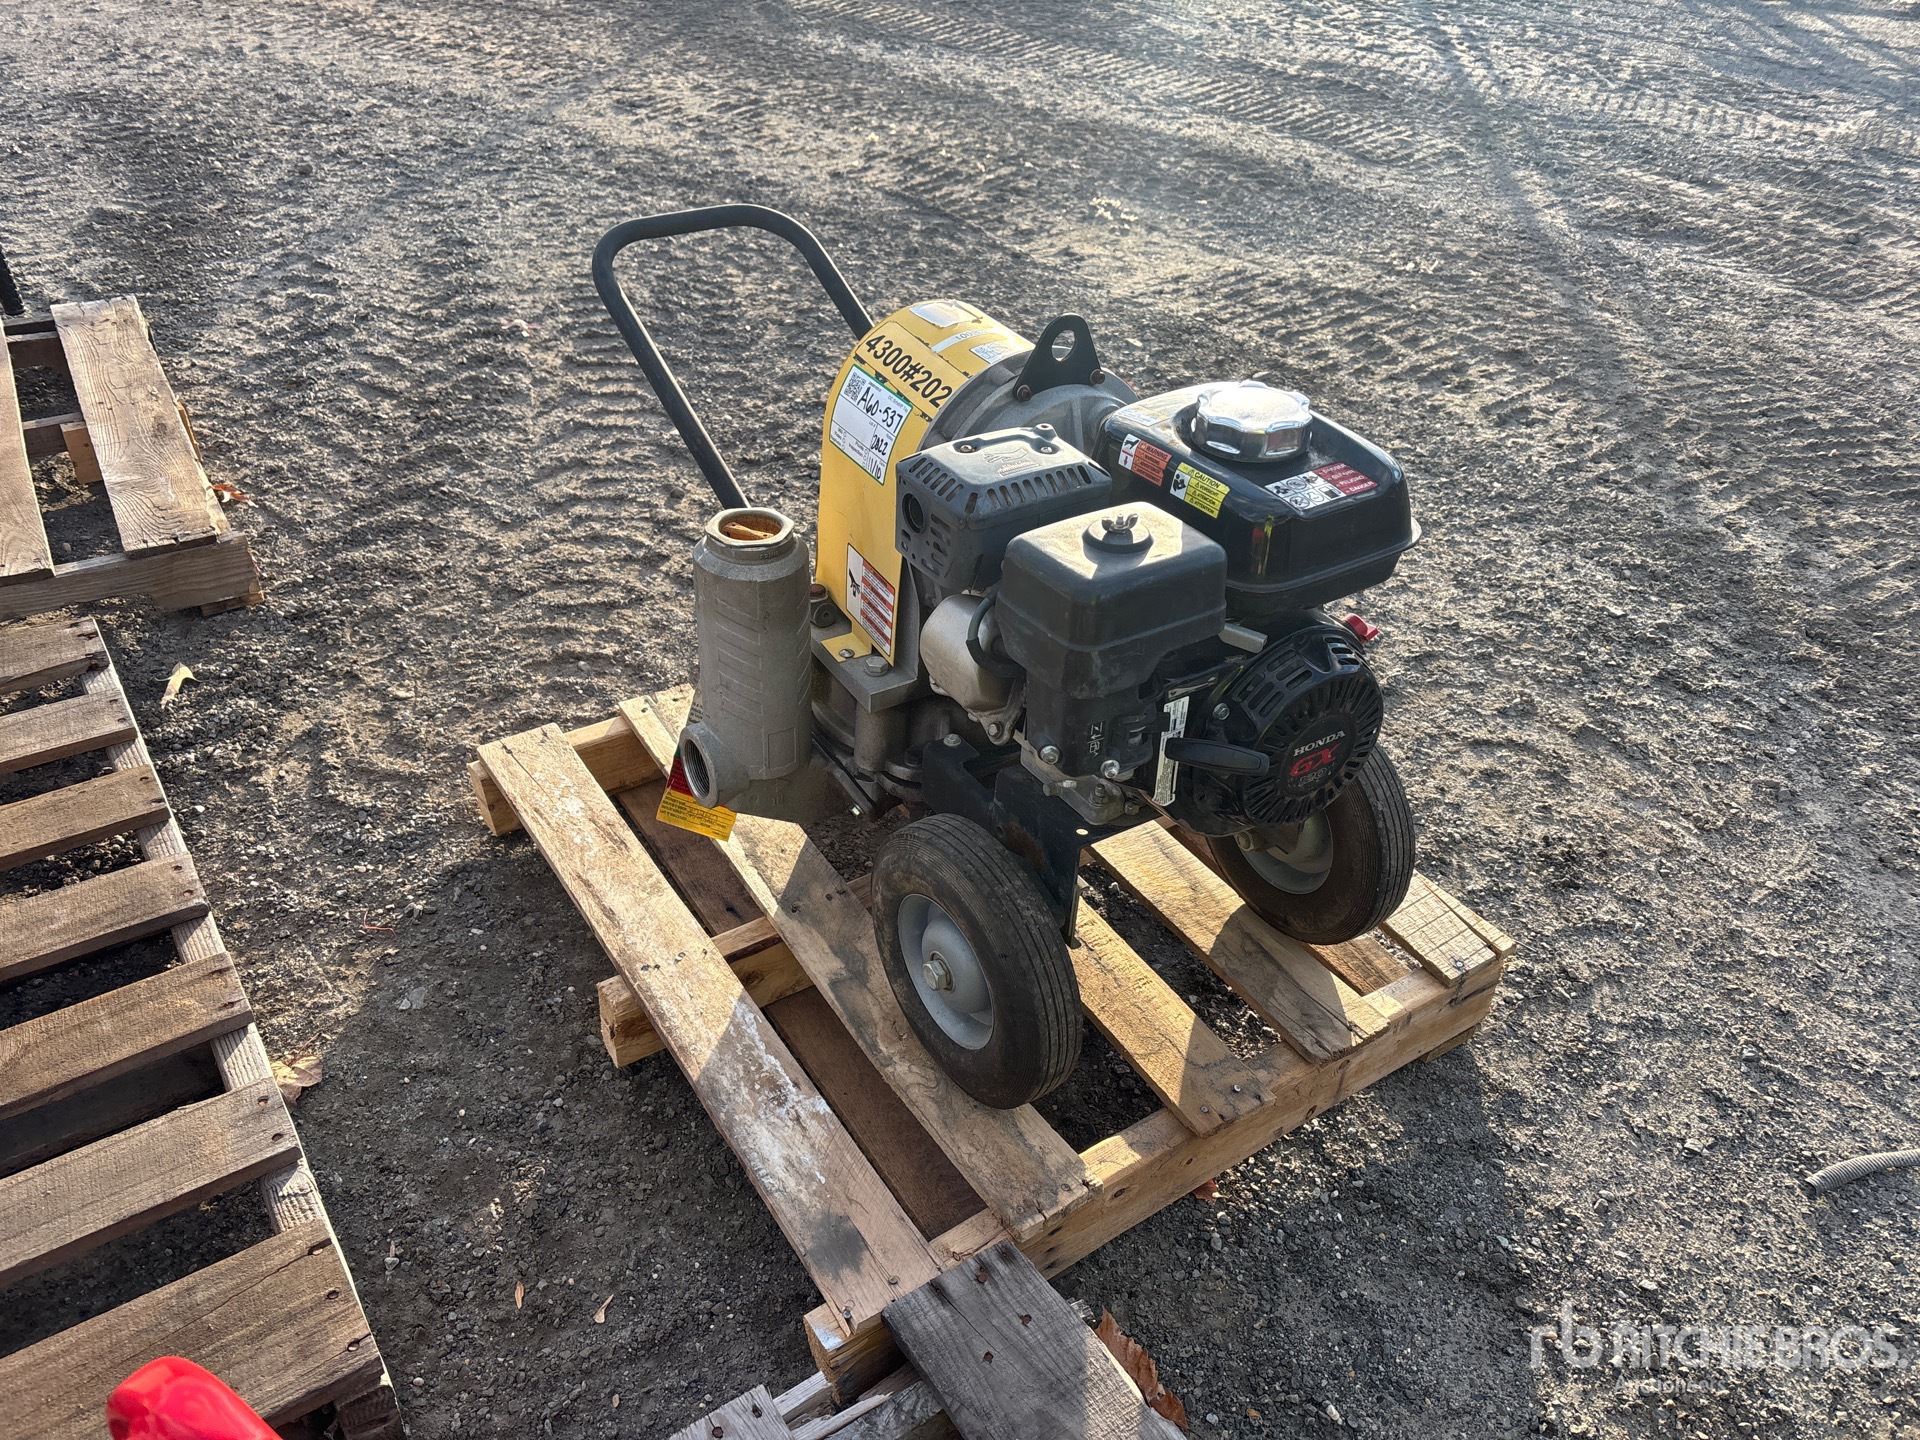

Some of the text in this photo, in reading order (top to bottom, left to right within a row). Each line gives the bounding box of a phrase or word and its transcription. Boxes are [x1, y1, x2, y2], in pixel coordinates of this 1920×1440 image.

[864, 334, 954, 409] 4300#202
[1194, 471, 1221, 489] CAUTION
[1293, 730, 1346, 757] HONDA
[1290, 742, 1343, 778] GX
